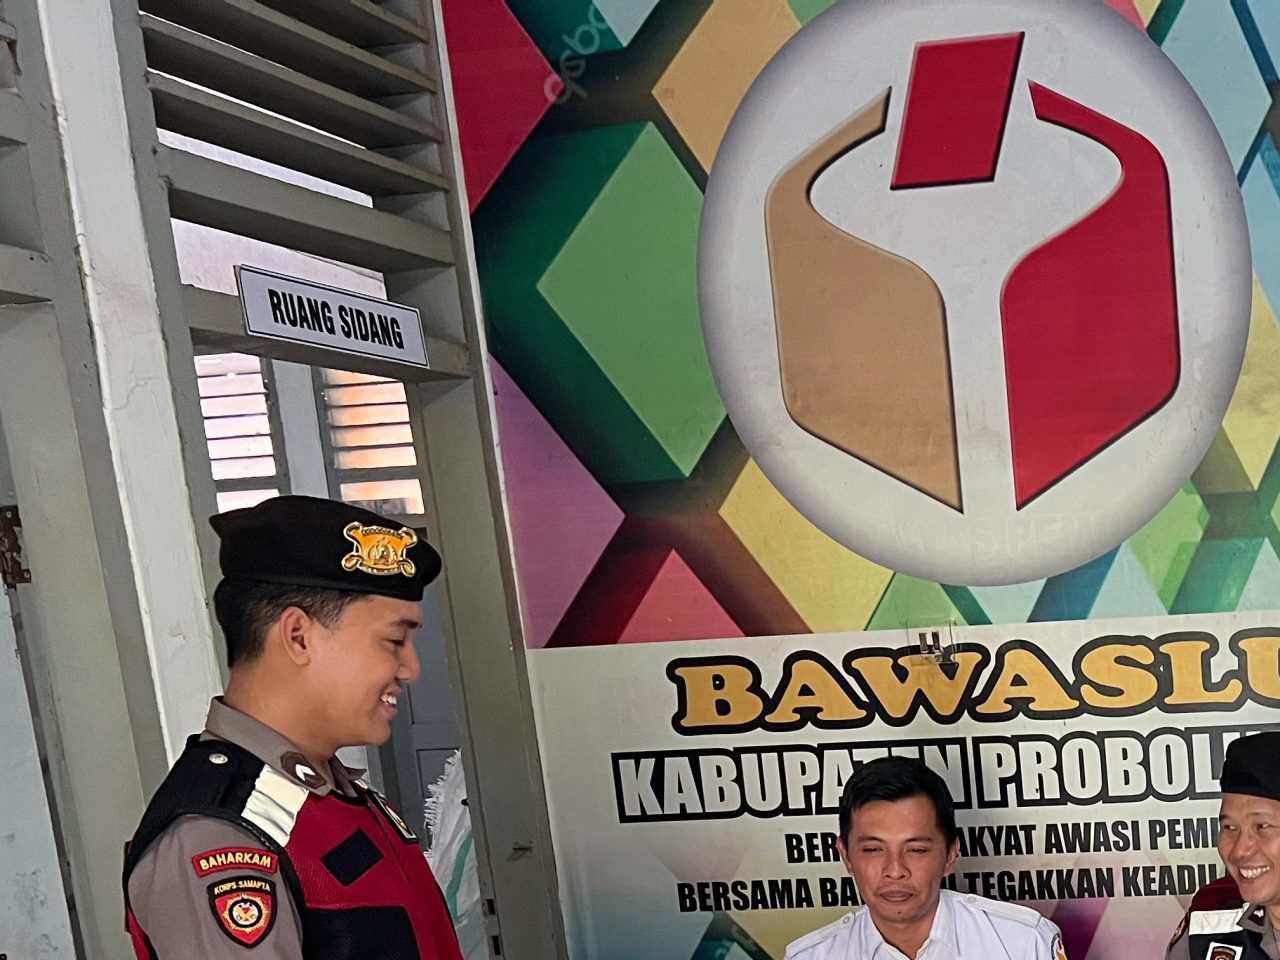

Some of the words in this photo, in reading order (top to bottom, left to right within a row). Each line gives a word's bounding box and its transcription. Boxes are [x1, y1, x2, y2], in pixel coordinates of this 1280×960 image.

[268, 288, 336, 335] RUANG
[338, 304, 405, 349] SIDANG
[611, 737, 971, 823] KABUPAN
[956, 824, 1036, 857] AKYAT
[1044, 820, 1141, 855] AWASI
[200, 852, 271, 870] BAHARKAM
[214, 881, 237, 895] KORPS
[677, 879, 814, 912] BERSAMA
[963, 867, 1115, 902] TEGAKKAN
